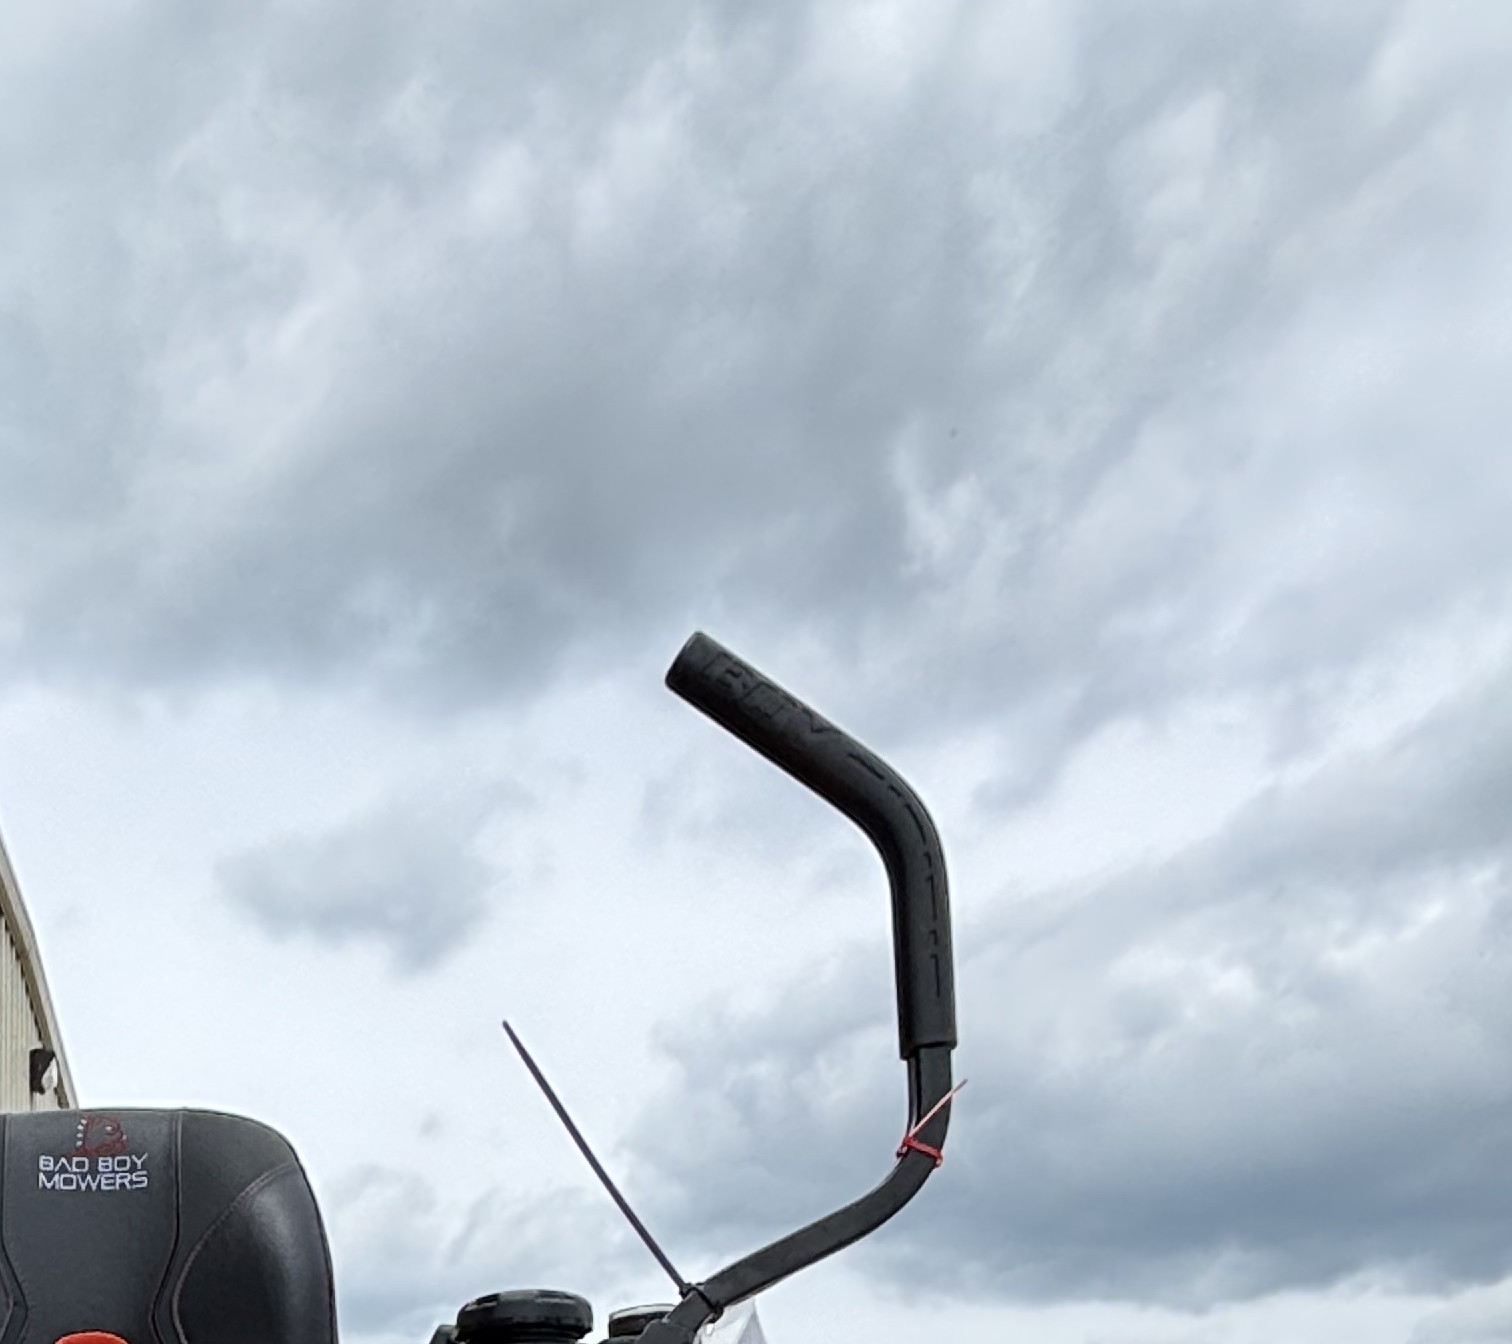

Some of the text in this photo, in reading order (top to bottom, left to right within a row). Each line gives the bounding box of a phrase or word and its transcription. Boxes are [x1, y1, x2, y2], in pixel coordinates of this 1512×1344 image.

[39, 1153, 148, 1172] BAD BOY
[38, 1171, 148, 1191] MOWERS
